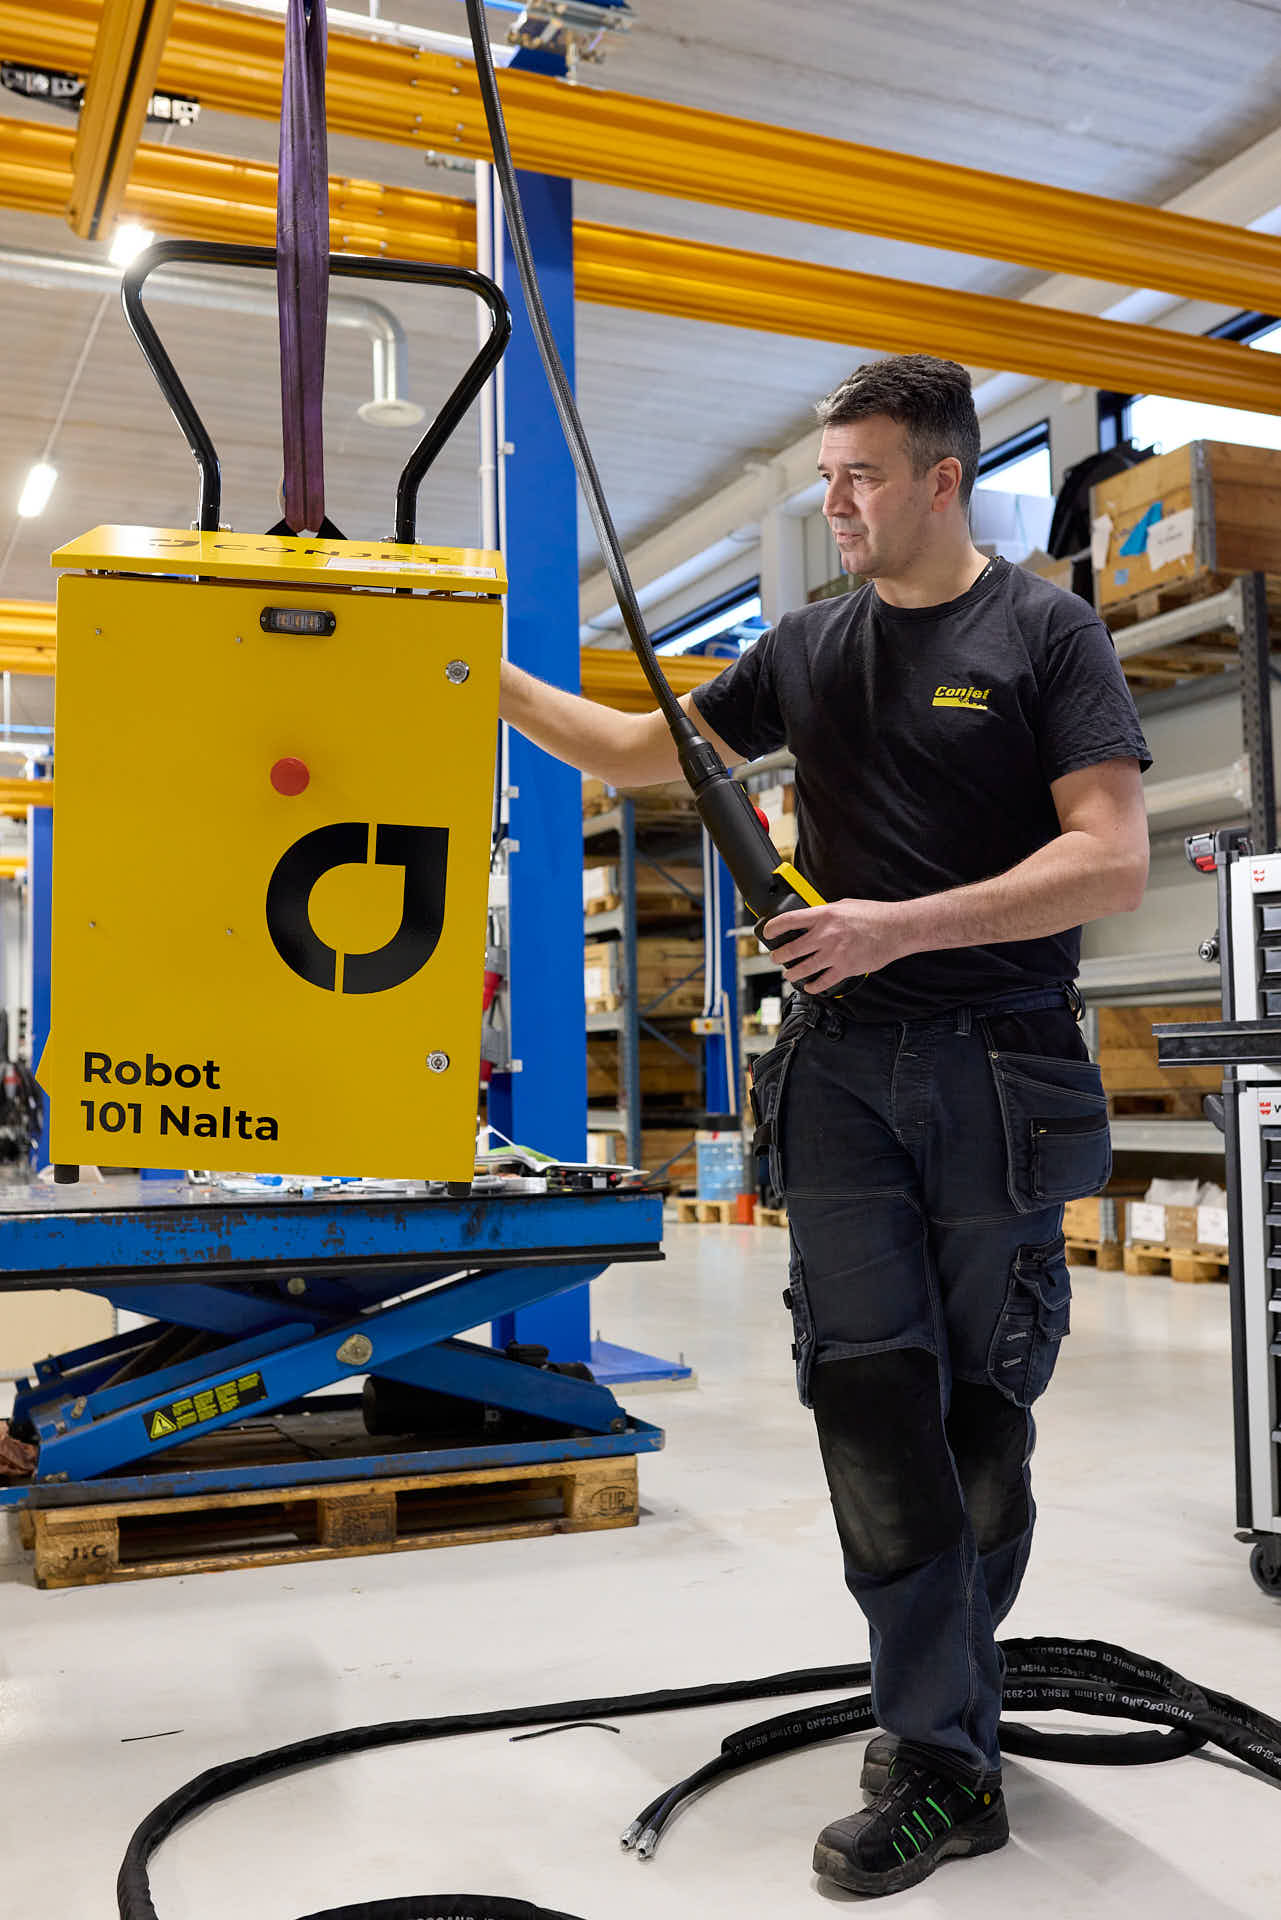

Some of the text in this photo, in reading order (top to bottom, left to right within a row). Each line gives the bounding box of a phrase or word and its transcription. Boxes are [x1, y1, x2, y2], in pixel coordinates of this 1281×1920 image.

[213, 544, 451, 563] CONJET
[934, 686, 992, 702] Conjet
[84, 1051, 221, 1090] Robot
[80, 1100, 279, 1141] 101 Nalta
[1026, 1646, 1098, 1658] DROSCAND
[1021, 1664, 1046, 1674] MSHA
[1041, 1688, 1070, 1699] MSHA
[806, 1706, 873, 1730] HYDROSCAND
[1121, 1696, 1195, 1721] HYDROSCAND
